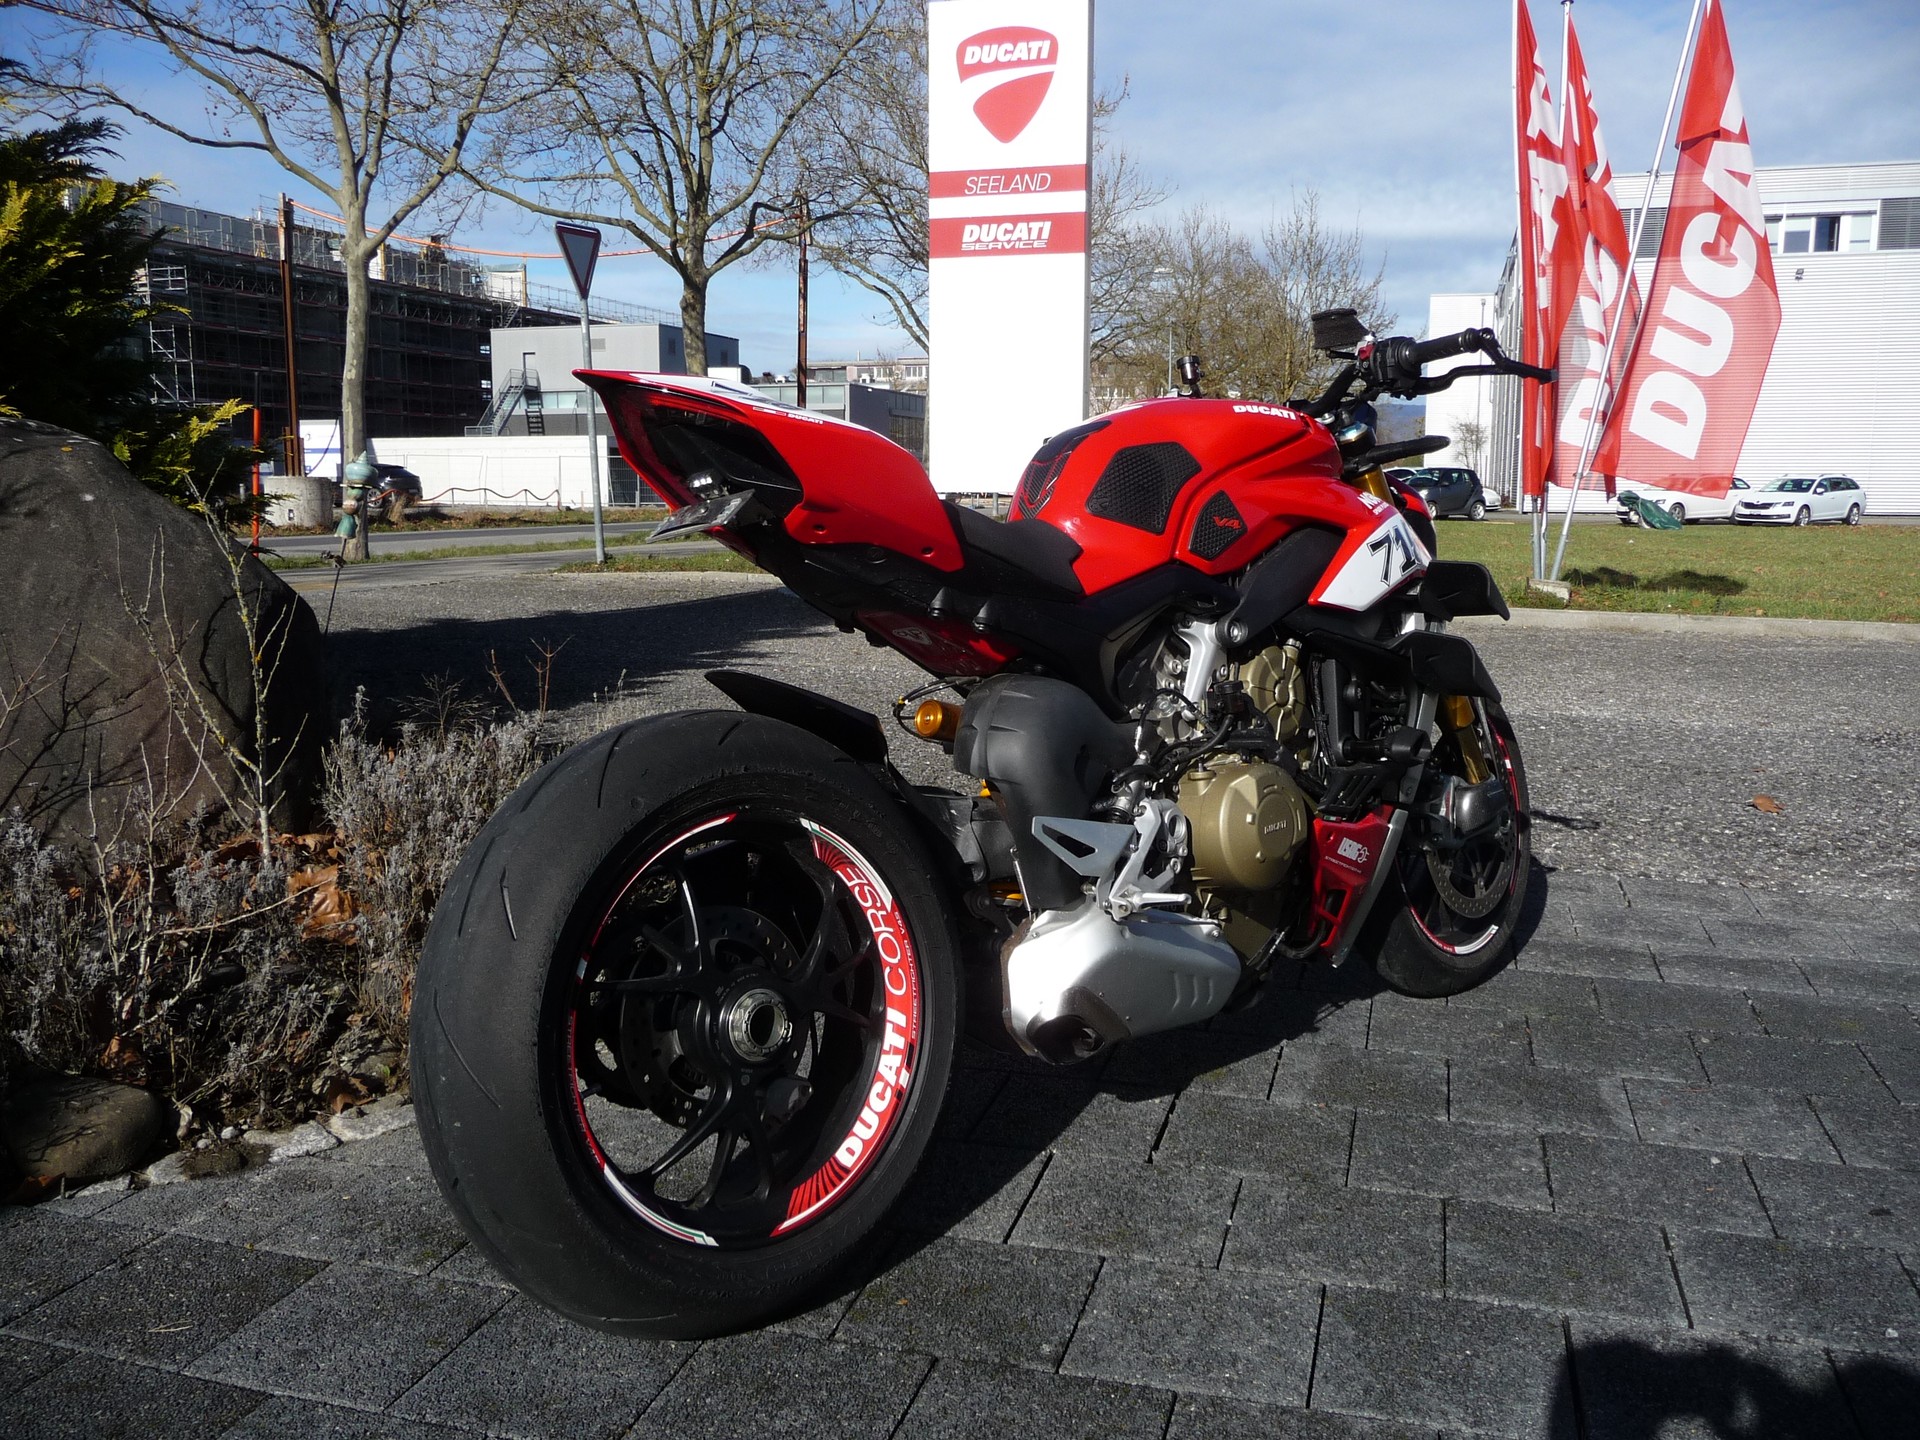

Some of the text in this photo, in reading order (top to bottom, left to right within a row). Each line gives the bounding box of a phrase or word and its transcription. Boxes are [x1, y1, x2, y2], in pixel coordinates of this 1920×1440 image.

[963, 40, 1051, 65] DUCATI
[964, 173, 1051, 195] SEELAND
[962, 221, 1052, 242] DUCATI
[960, 240, 1048, 251] SERVICE
[787, 412, 824, 425] DUCATI
[1232, 404, 1297, 421] DUCATI
[1212, 515, 1241, 529] V4
[1367, 525, 1418, 587] 71
[903, 939, 918, 1041] STREETFIGHTER
[835, 866, 907, 1168] DUCATI CORSE
